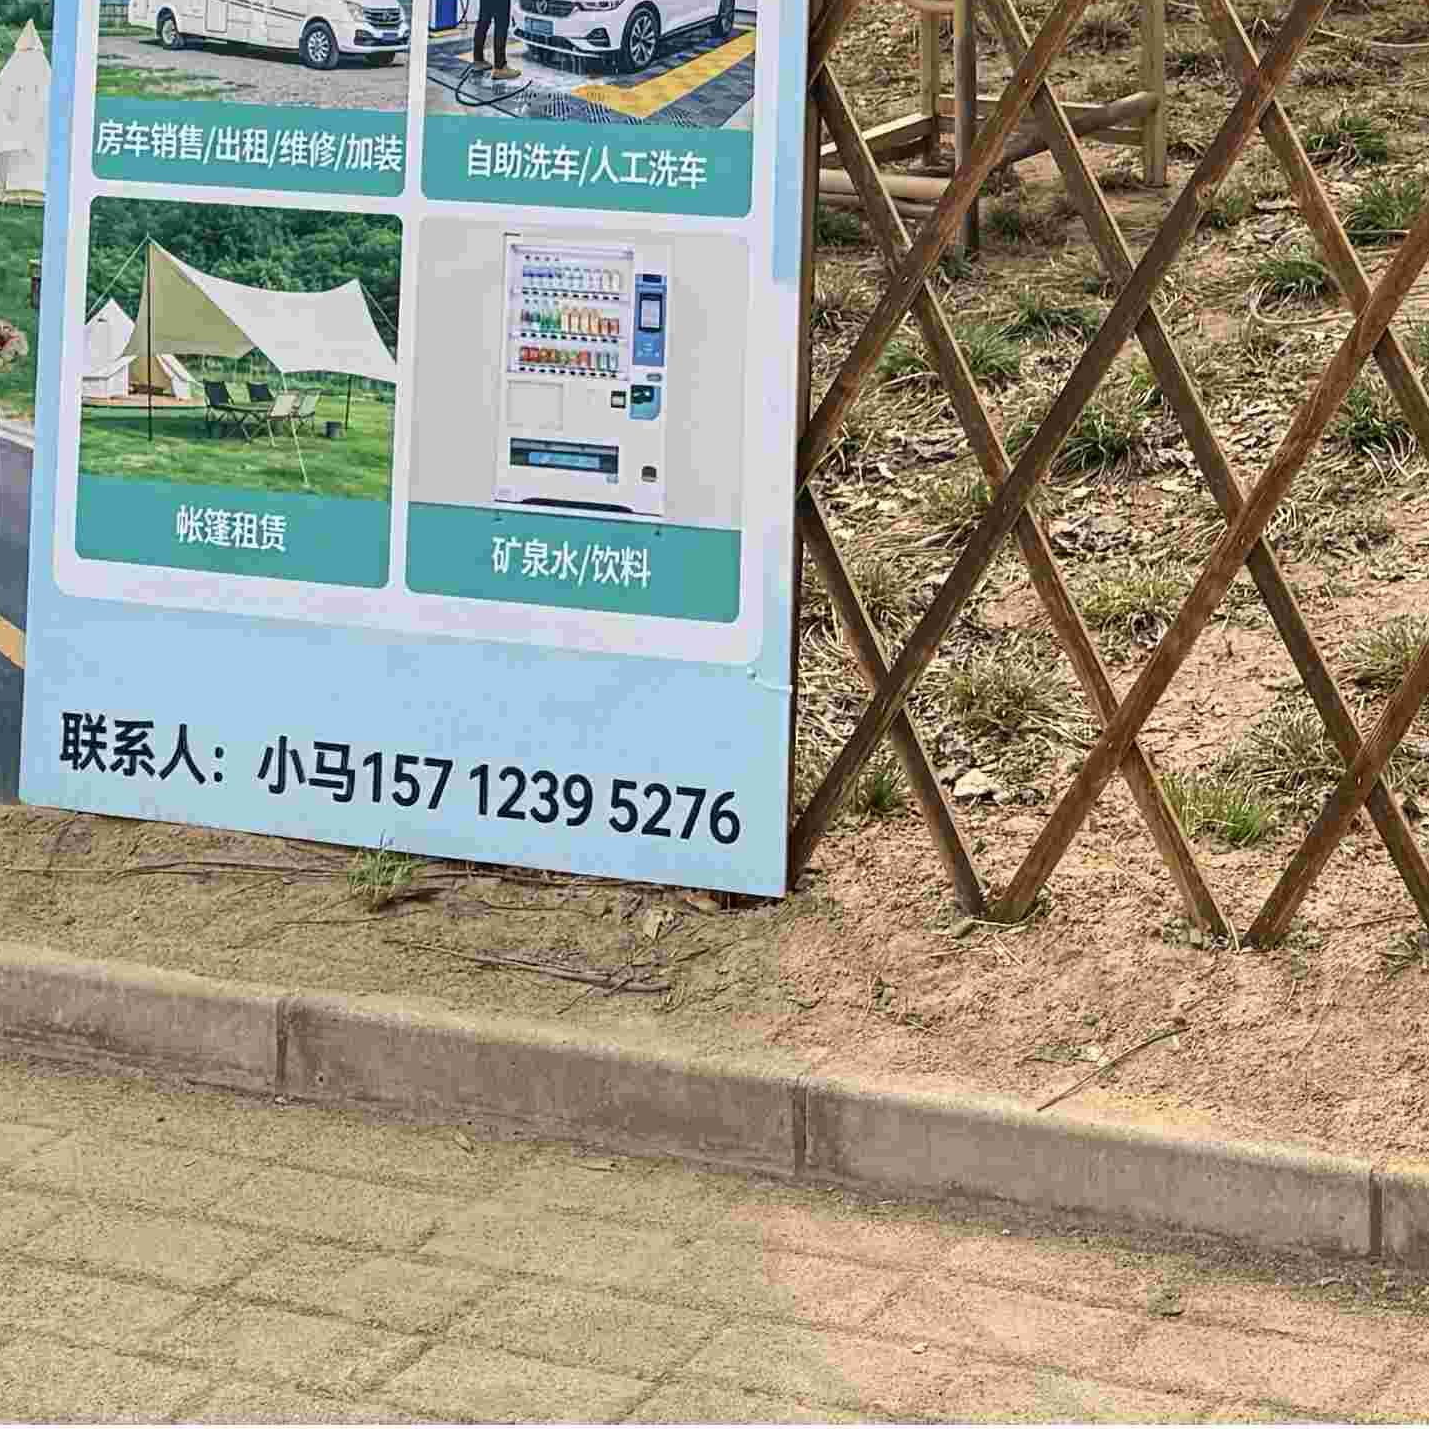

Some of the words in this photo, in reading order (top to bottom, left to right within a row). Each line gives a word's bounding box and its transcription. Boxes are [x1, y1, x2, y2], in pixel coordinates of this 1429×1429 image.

[96, 118, 404, 175] 房车销售/出租/维修/加装
[465, 139, 708, 190] 自助洗车/人工洗车
[175, 505, 288, 553] 帐篷租赁
[490, 535, 652, 589] 矿泉水/饮料
[469, 762, 594, 828] 1239
[609, 779, 741, 846] 5276
